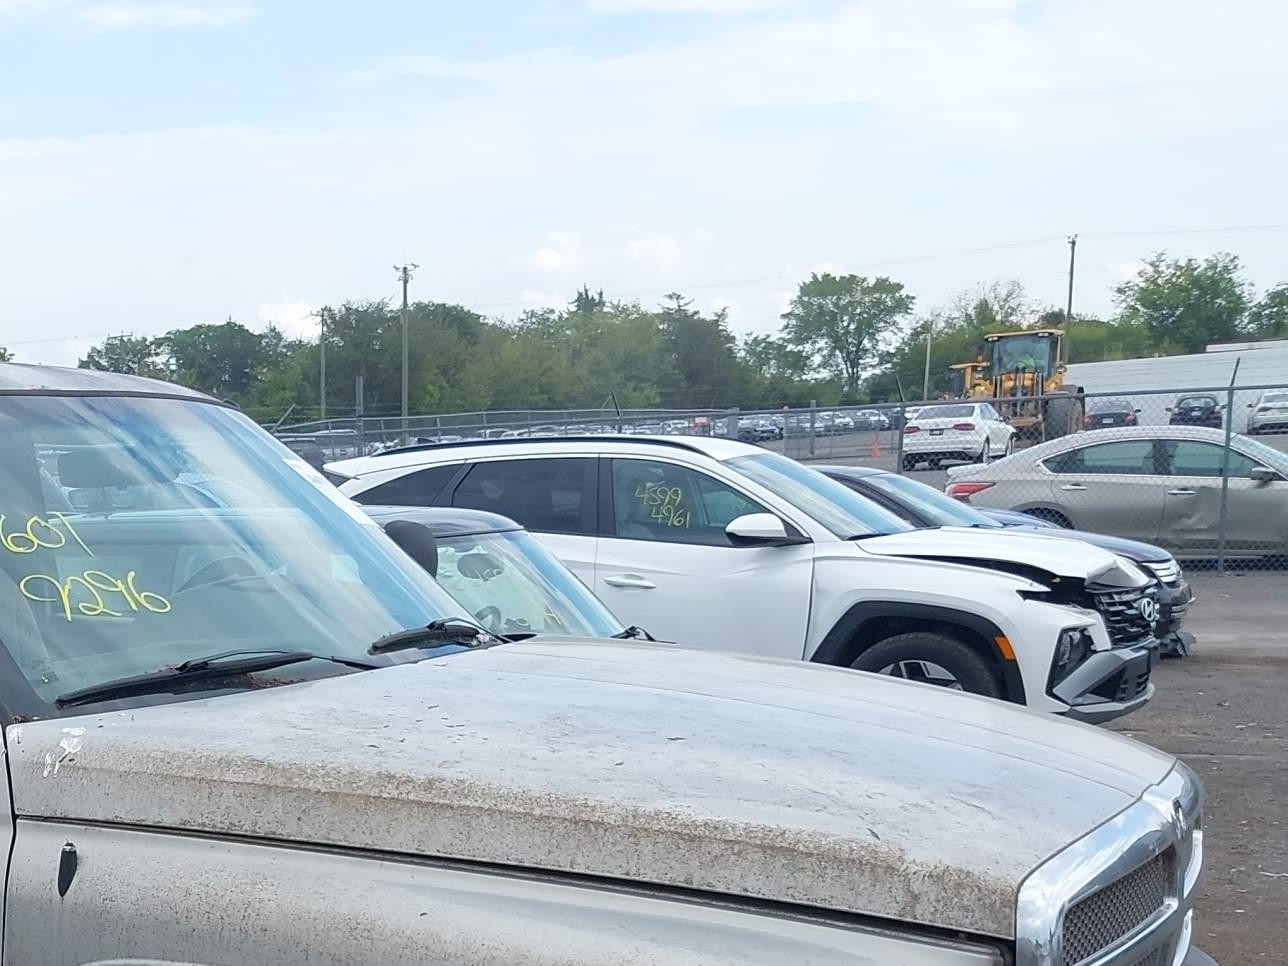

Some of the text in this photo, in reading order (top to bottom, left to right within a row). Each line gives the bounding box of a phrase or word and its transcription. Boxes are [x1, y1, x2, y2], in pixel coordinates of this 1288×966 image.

[634, 481, 682, 507] 4599
[651, 505, 690, 528] 4961
[20, 570, 171, 622] 9296
